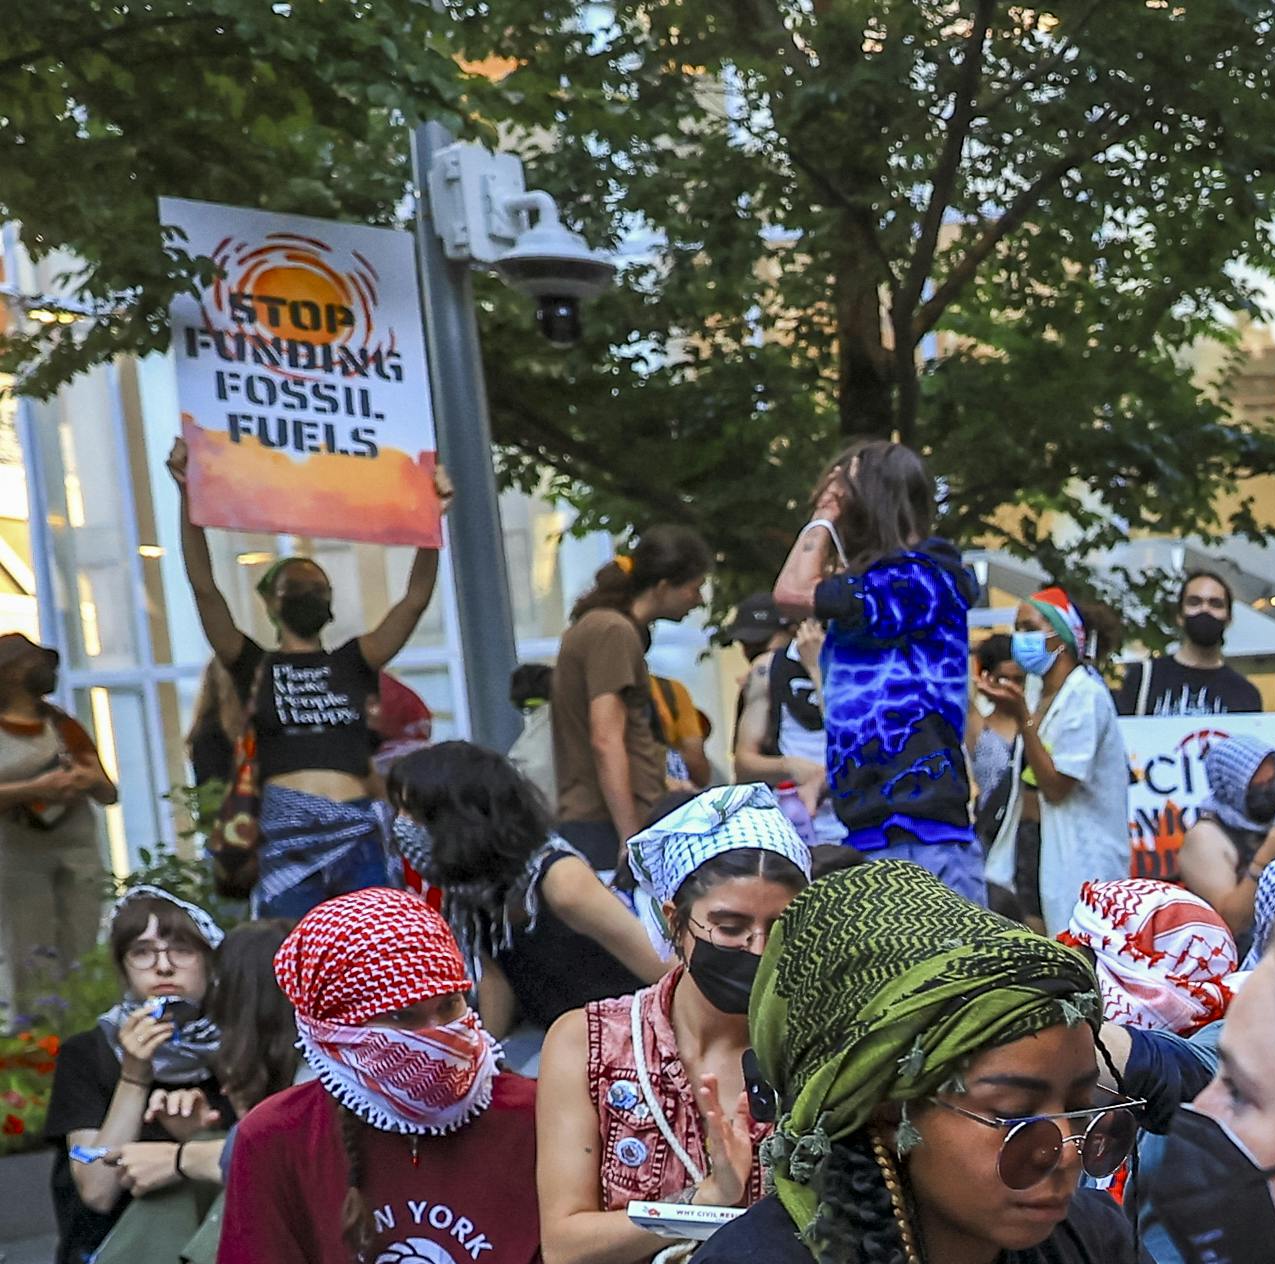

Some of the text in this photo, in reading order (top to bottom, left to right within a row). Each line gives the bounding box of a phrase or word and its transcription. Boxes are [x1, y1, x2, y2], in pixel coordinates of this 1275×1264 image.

[230, 293, 354, 333] STOP
[185, 327, 404, 383] FUNDING
[215, 370, 386, 421] FOSSIL
[227, 413, 379, 458] FUELS
[408, 1200, 493, 1261] YORK
[676, 1209, 695, 1217] WHY
[697, 1210, 718, 1219] CIVIL
